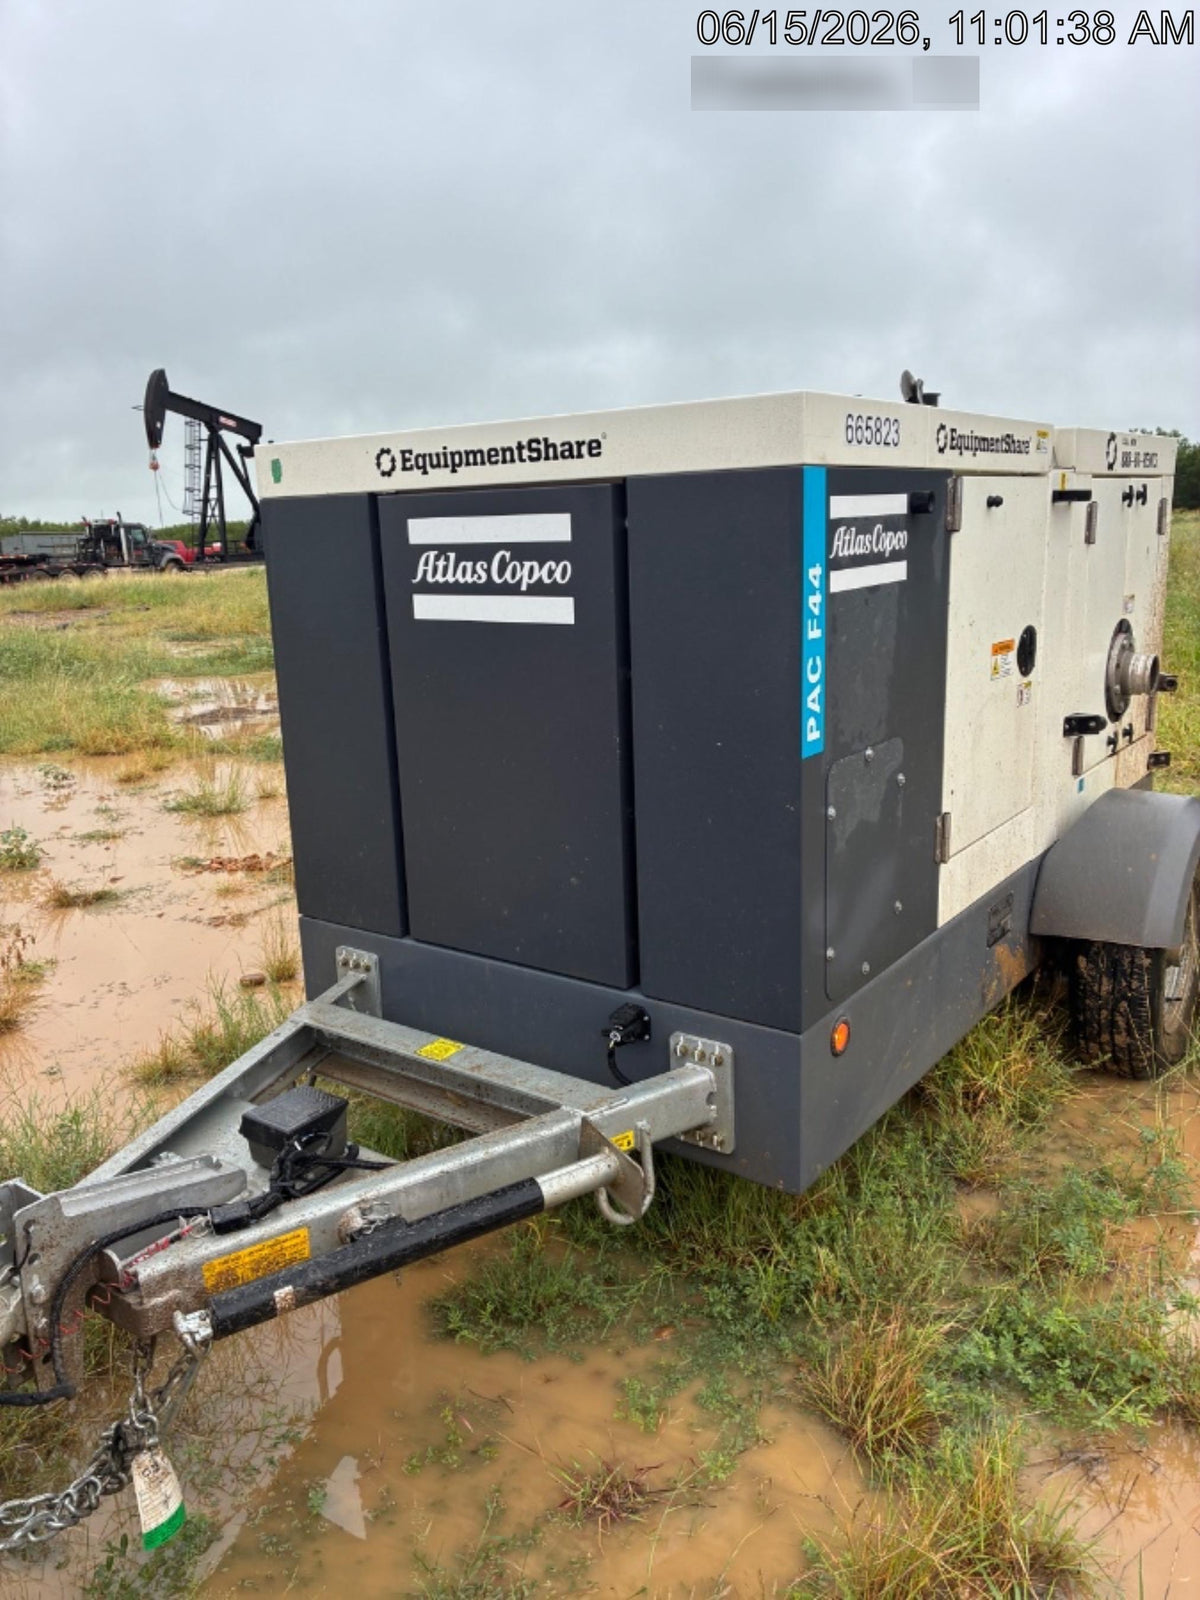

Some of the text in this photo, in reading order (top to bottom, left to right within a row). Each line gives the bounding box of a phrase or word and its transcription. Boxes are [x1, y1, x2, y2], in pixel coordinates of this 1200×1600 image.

[846, 413, 900, 447] 665823
[949, 427, 1031, 457] EquipmentShare
[400, 437, 603, 475] EquipmentShare
[829, 523, 908, 559] Atlas Copco
[412, 549, 572, 591] Atlas Copco
[806, 563, 823, 743] PAC F44
